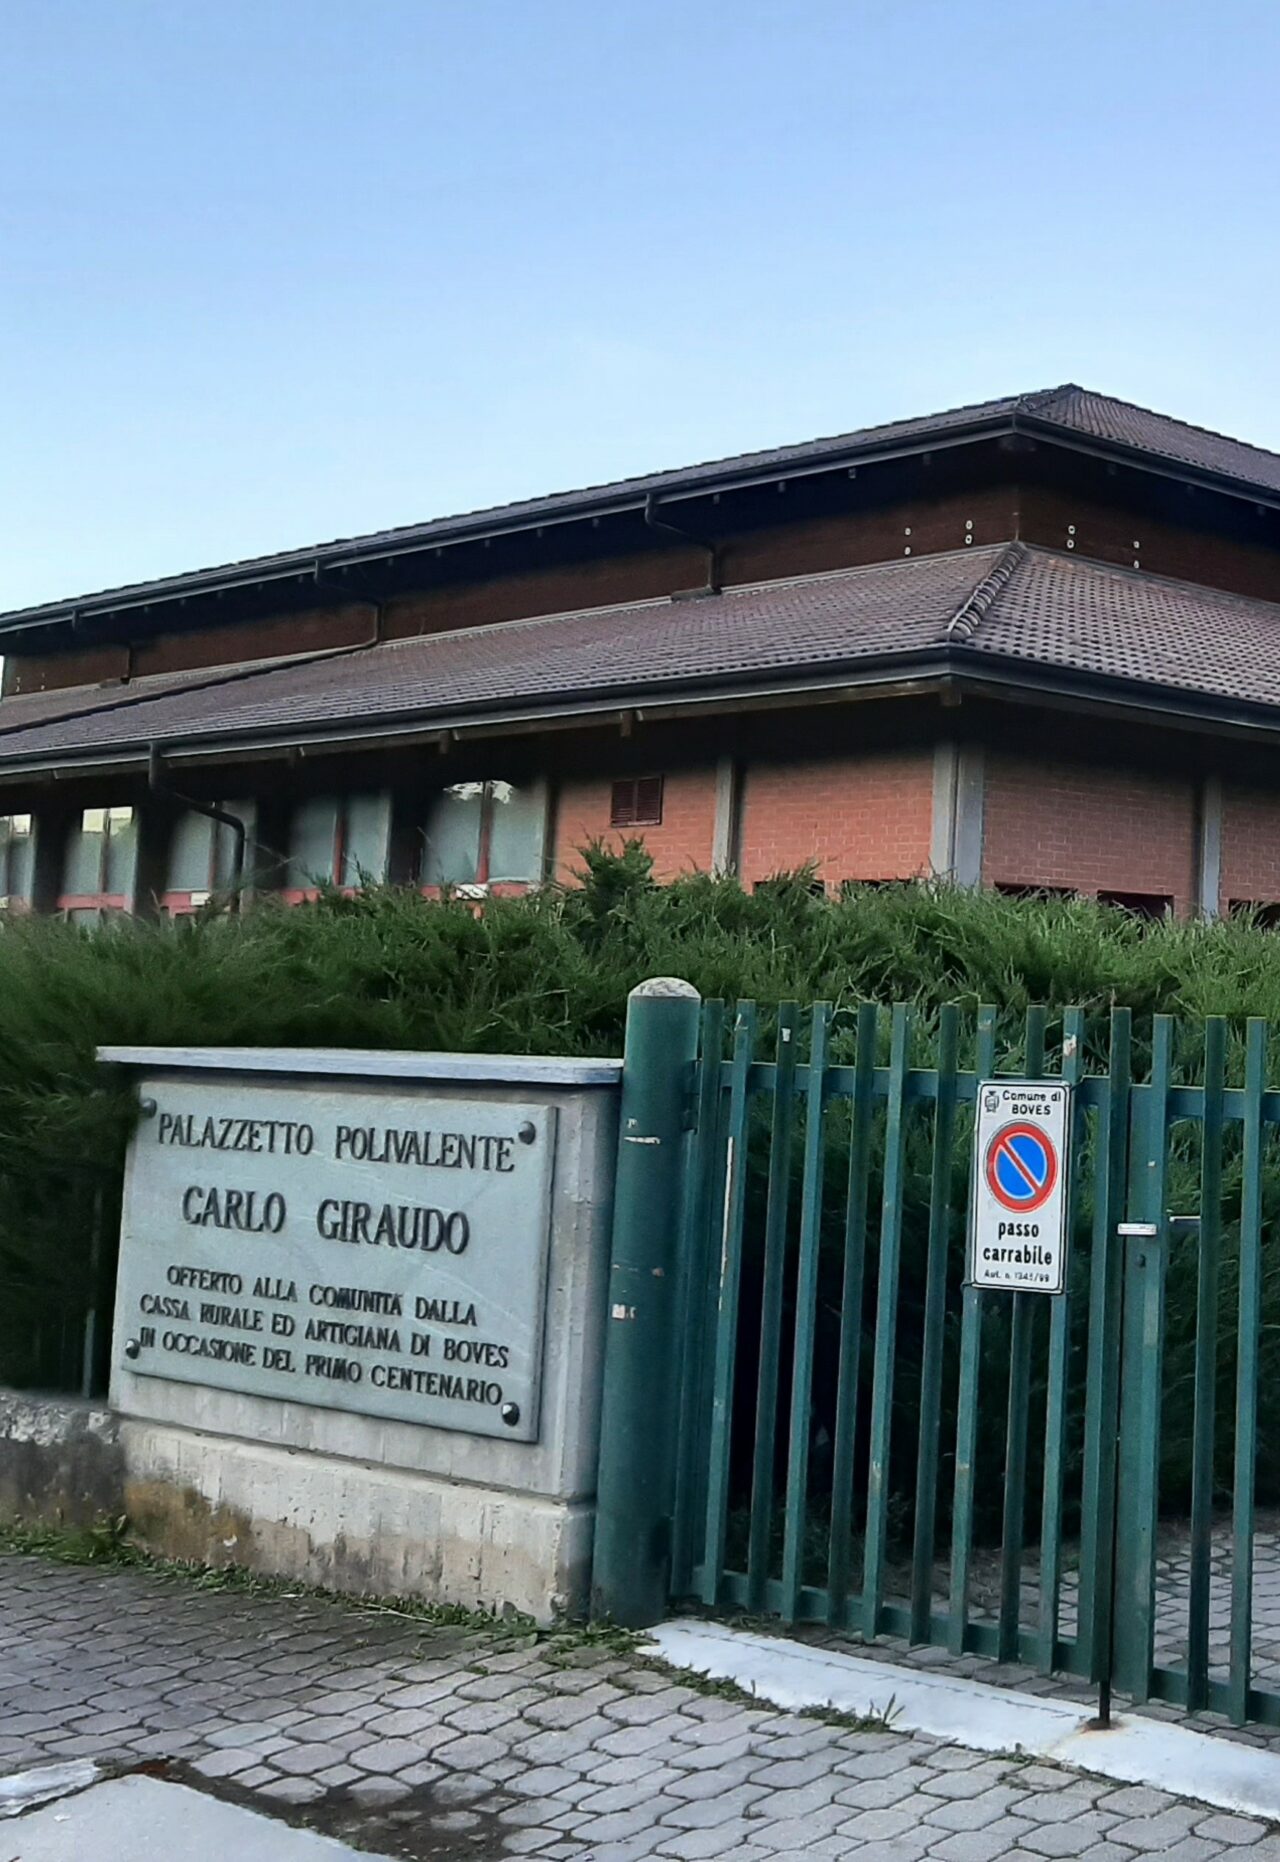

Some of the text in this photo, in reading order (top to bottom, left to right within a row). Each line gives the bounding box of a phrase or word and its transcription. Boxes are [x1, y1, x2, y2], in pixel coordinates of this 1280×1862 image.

[1002, 1089, 1061, 1102] Comune di
[1012, 1104, 1051, 1115] BOVES
[159, 1113, 515, 1172] PALAZZETTO POLIVALENTE
[182, 1186, 470, 1255] CARLO GIRAUDO
[999, 1222, 1039, 1240] passo
[983, 1244, 1052, 1265] carrabile
[167, 1265, 242, 1295] OFFERTO
[253, 1277, 298, 1303] ALLA
[415, 1296, 477, 1327] DALLA
[140, 1294, 509, 1369] CASSA RURALE ED ARTIGIANA DI BOVES
[140, 1327, 502, 1405] IN OCCASIONE DEL PRIMO CENTENARIO
